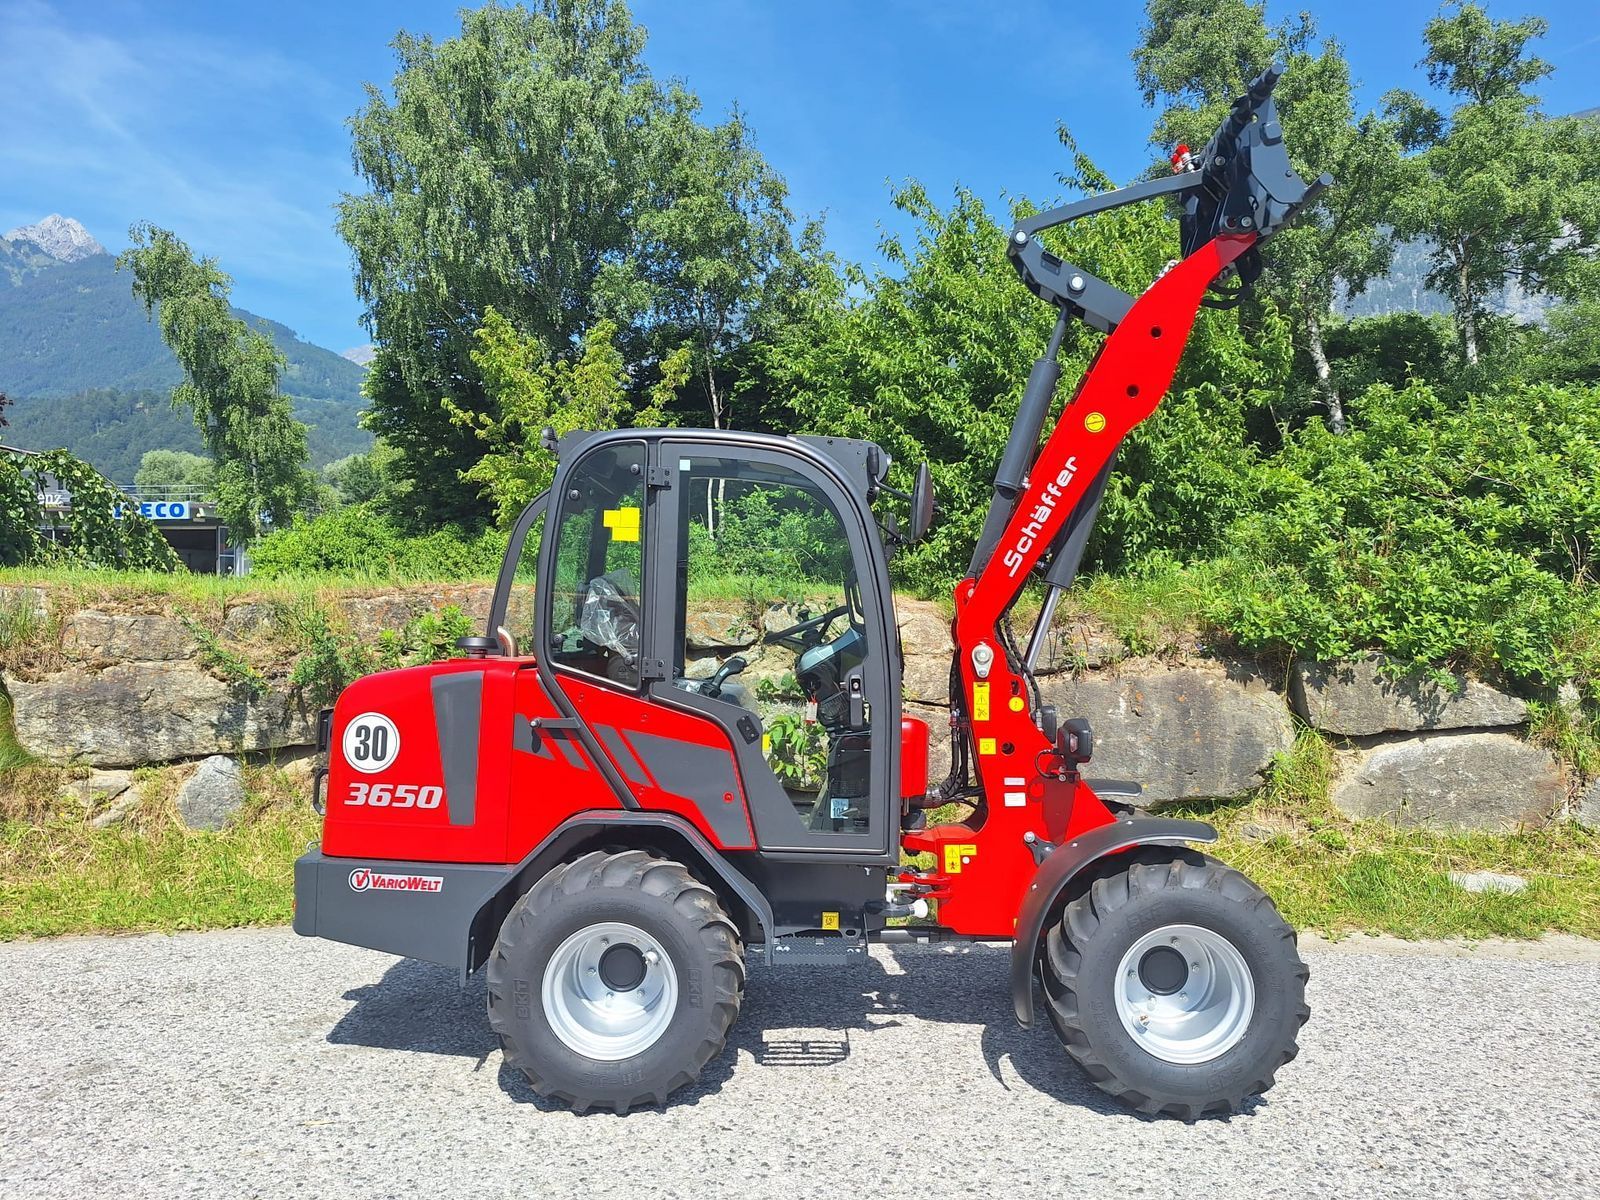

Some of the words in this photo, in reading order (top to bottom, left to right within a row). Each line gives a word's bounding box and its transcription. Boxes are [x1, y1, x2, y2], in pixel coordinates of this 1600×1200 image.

[113, 503, 185, 518] IECO
[1003, 456, 1078, 577] Schäffer
[354, 725, 388, 761] 30
[344, 783, 443, 809] 3650
